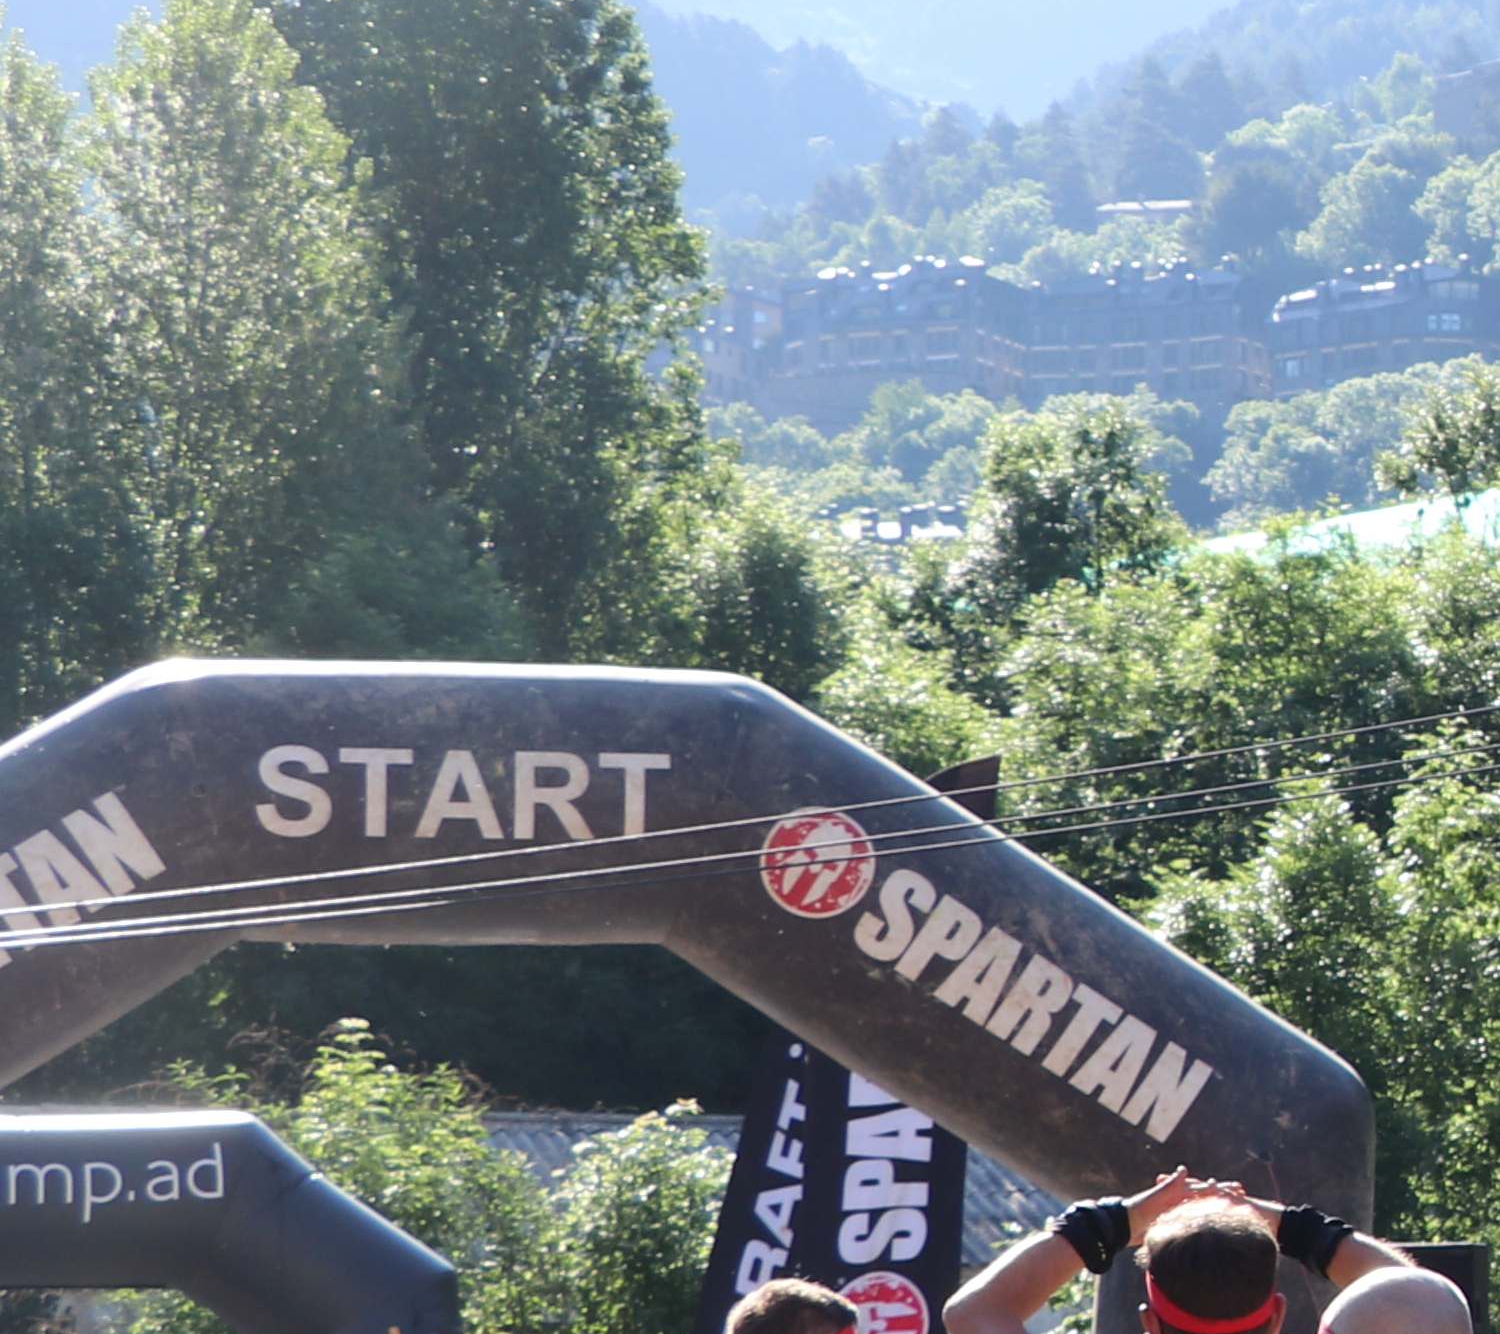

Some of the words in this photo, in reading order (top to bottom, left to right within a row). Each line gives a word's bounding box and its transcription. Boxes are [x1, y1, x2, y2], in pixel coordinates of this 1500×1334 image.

[256, 744, 671, 840] START
[853, 869, 1213, 1144] SPARTAN
[8, 1141, 225, 1223] mp.ad
